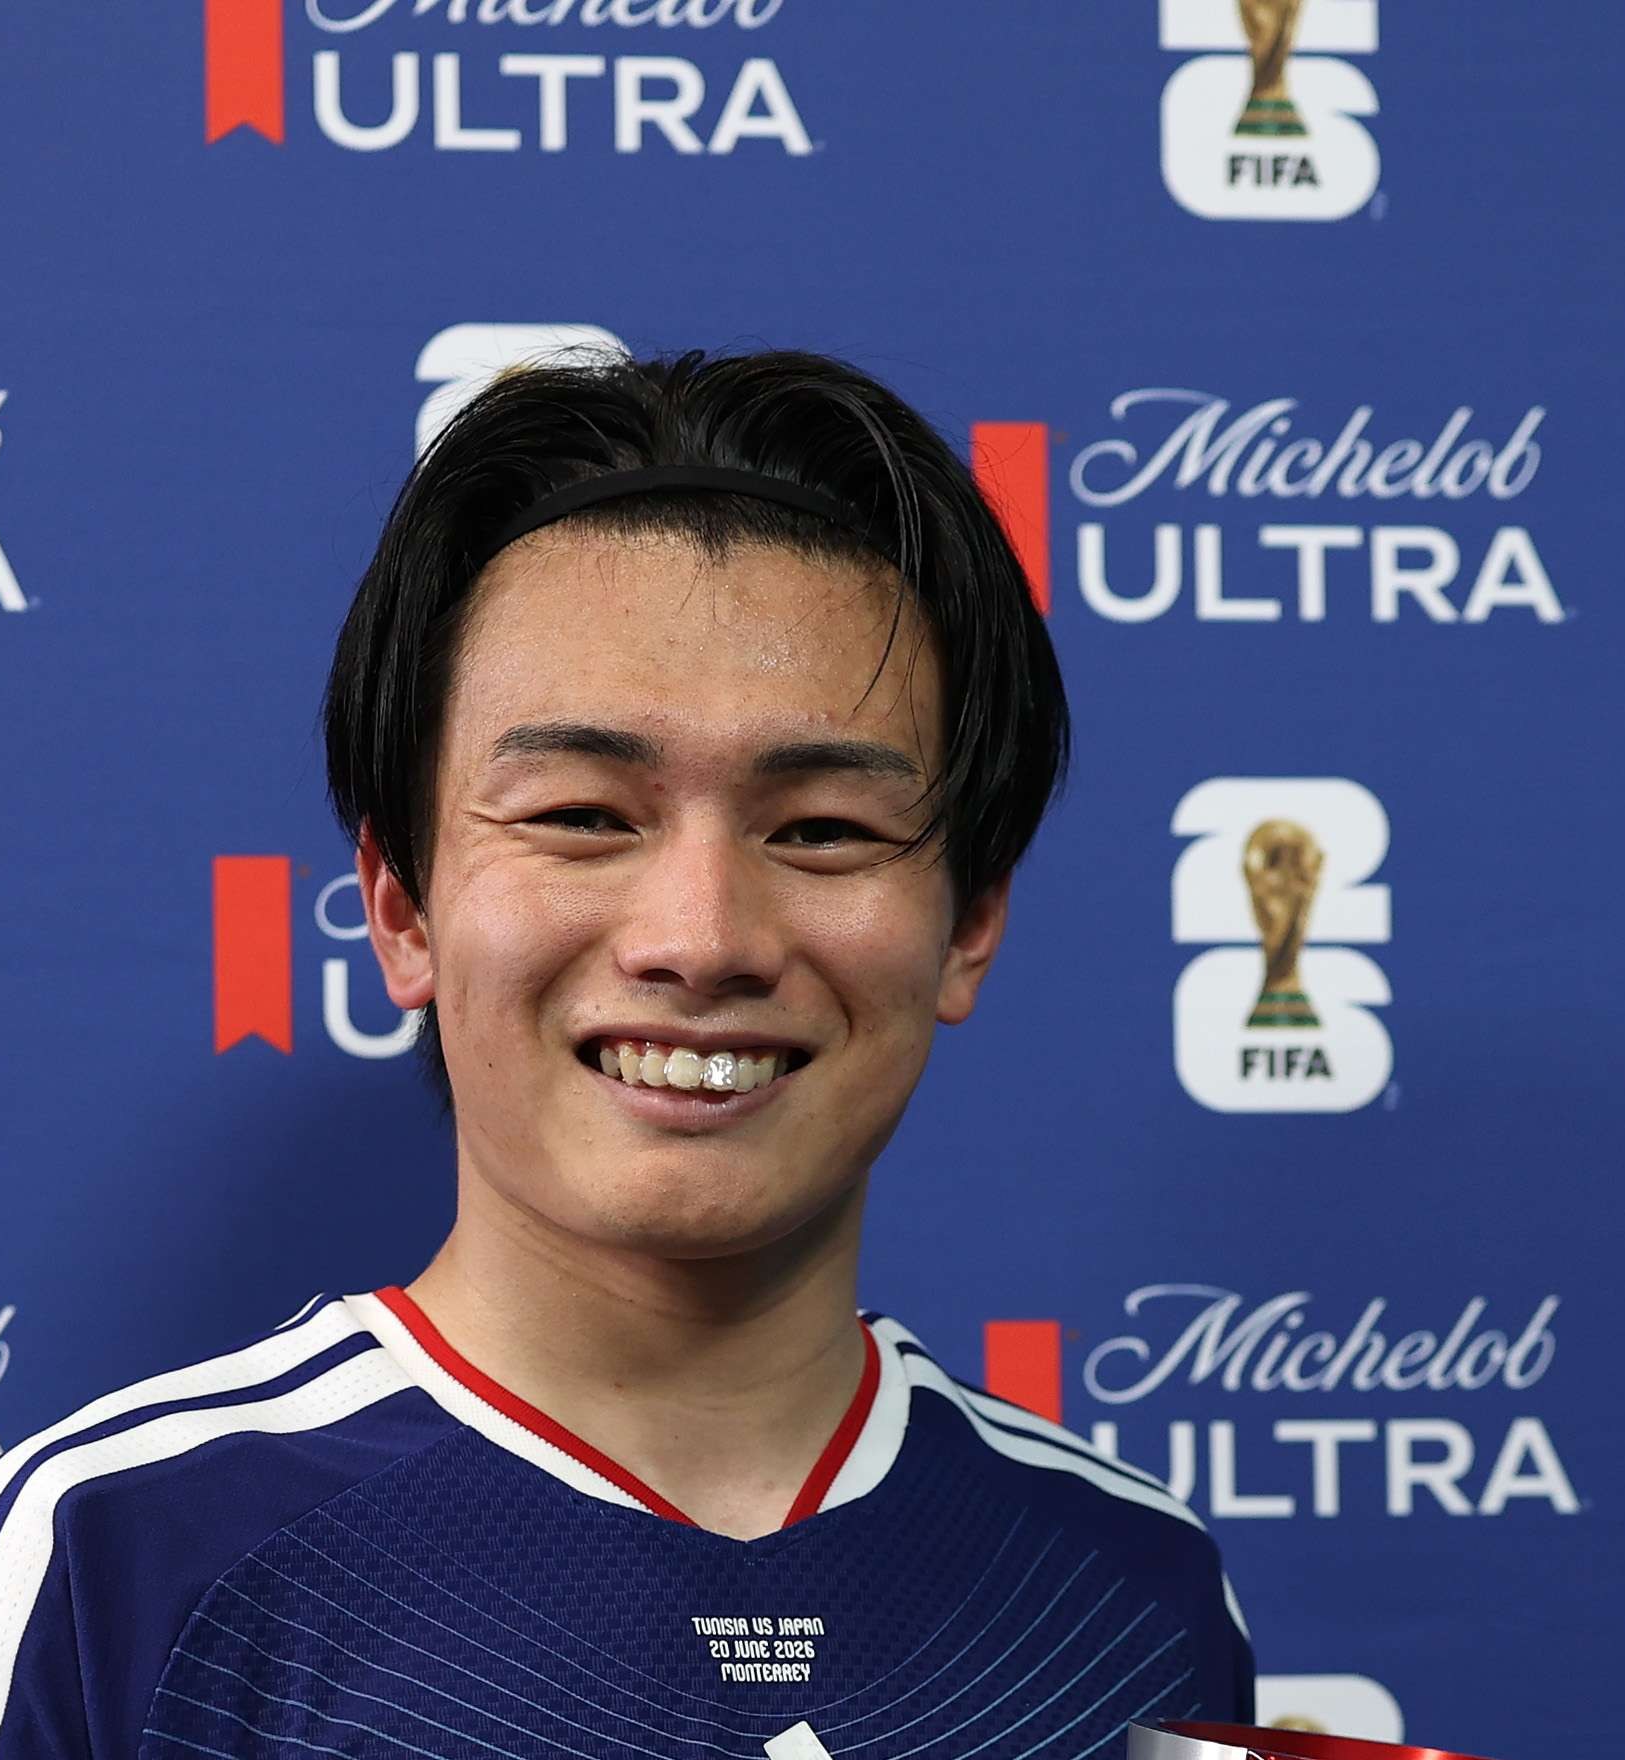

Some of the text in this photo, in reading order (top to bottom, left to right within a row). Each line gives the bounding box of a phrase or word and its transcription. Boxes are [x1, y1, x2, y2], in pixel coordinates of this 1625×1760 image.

[314, 51, 812, 155] ULTRA
[1229, 155, 1317, 186] FIFA
[1071, 390, 1544, 506] Michelob
[1078, 524, 1563, 622] ULTRA
[1242, 1048, 1331, 1078] FIFA
[1084, 1285, 1558, 1403] Michelob
[691, 1617, 749, 1636] TUNISIA
[778, 1617, 825, 1636] JAPAN
[709, 1640, 815, 1659] 20 JUNE 2026
[721, 1663, 810, 1682] MONTERREY
